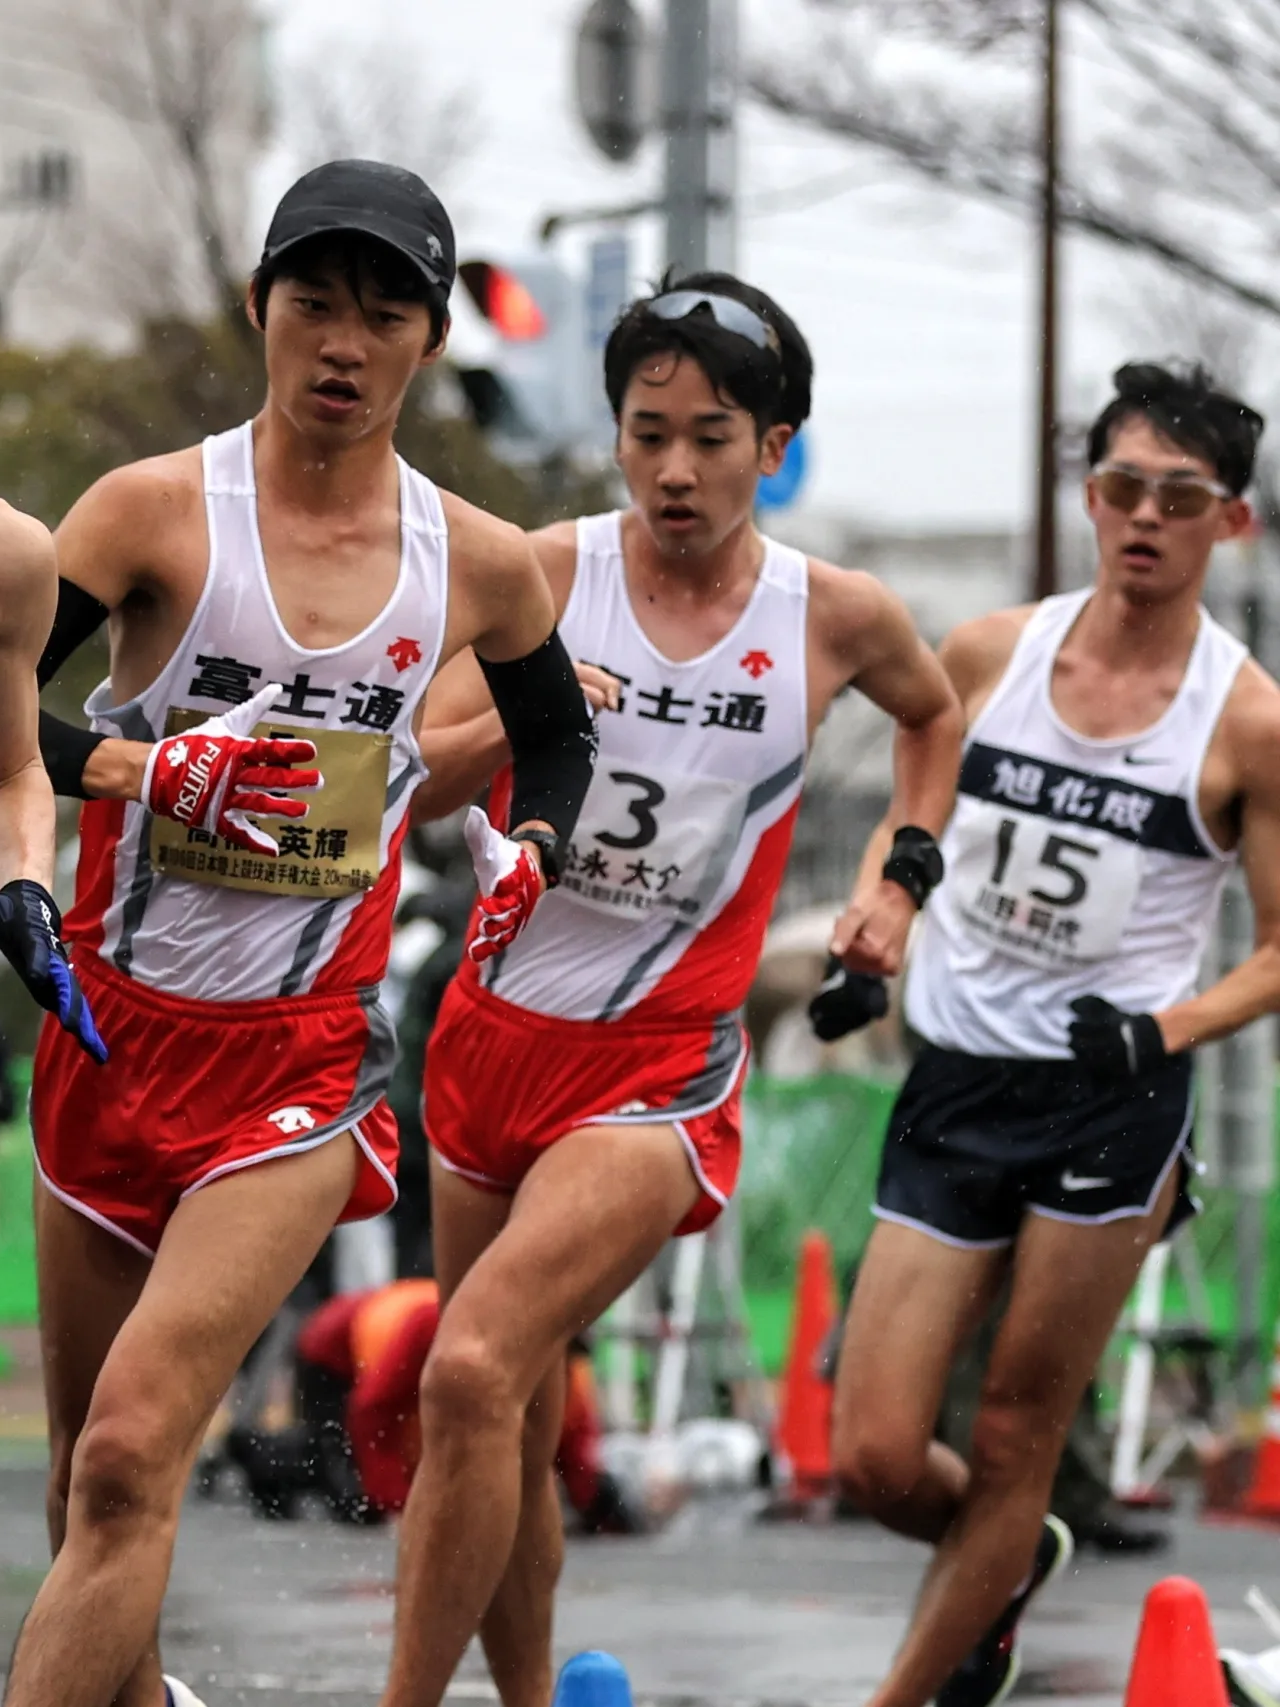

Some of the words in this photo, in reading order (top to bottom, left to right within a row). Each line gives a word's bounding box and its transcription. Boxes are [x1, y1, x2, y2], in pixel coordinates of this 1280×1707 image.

[188, 653, 406, 732] 富士通
[579, 659, 767, 734] 士通
[172, 741, 221, 821] FUJITSU
[594, 771, 666, 850] 3
[991, 757, 1156, 835] 旭化成
[278, 824, 348, 861] 英輝
[991, 819, 1101, 906] 15
